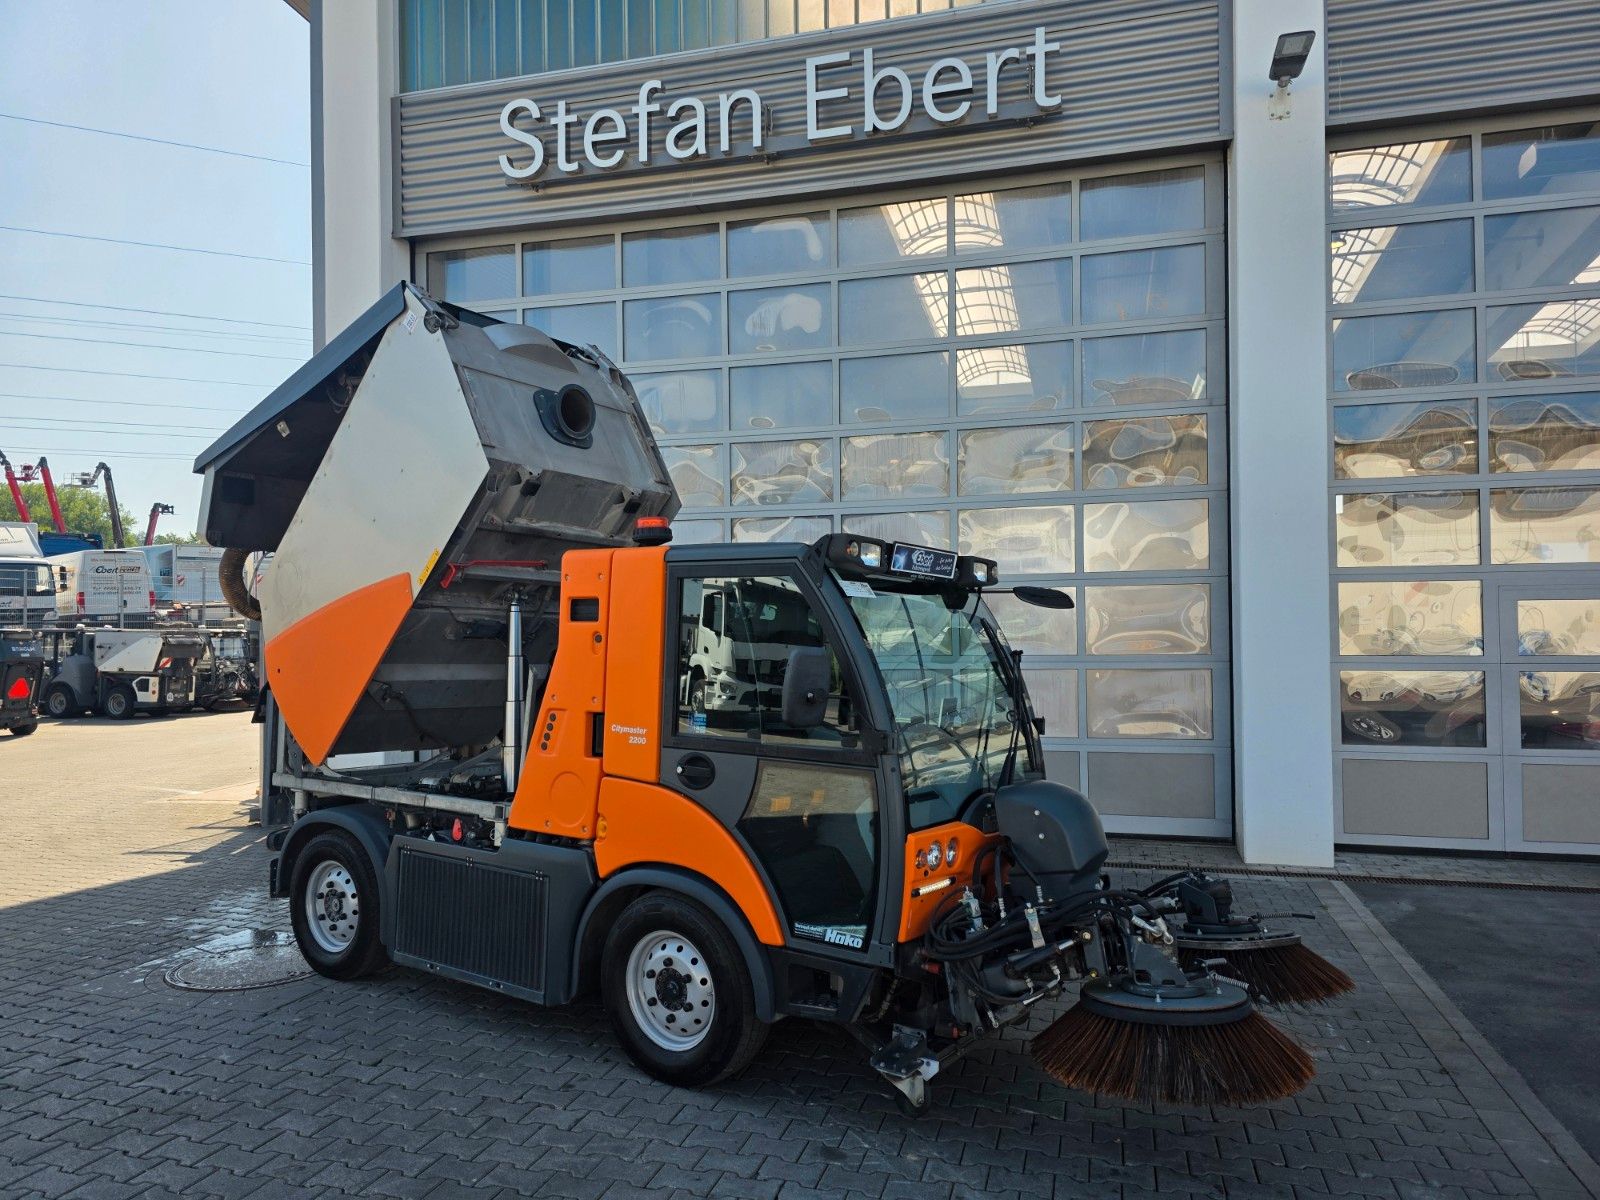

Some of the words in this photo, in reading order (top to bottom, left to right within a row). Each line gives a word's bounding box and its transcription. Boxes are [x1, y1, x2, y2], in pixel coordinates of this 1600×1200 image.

[498, 79, 764, 179] Stefan
[805, 26, 1062, 141] Ebert
[611, 724, 647, 735] Citymaster
[629, 736, 647, 745] 2200
[824, 927, 863, 949] Hako
